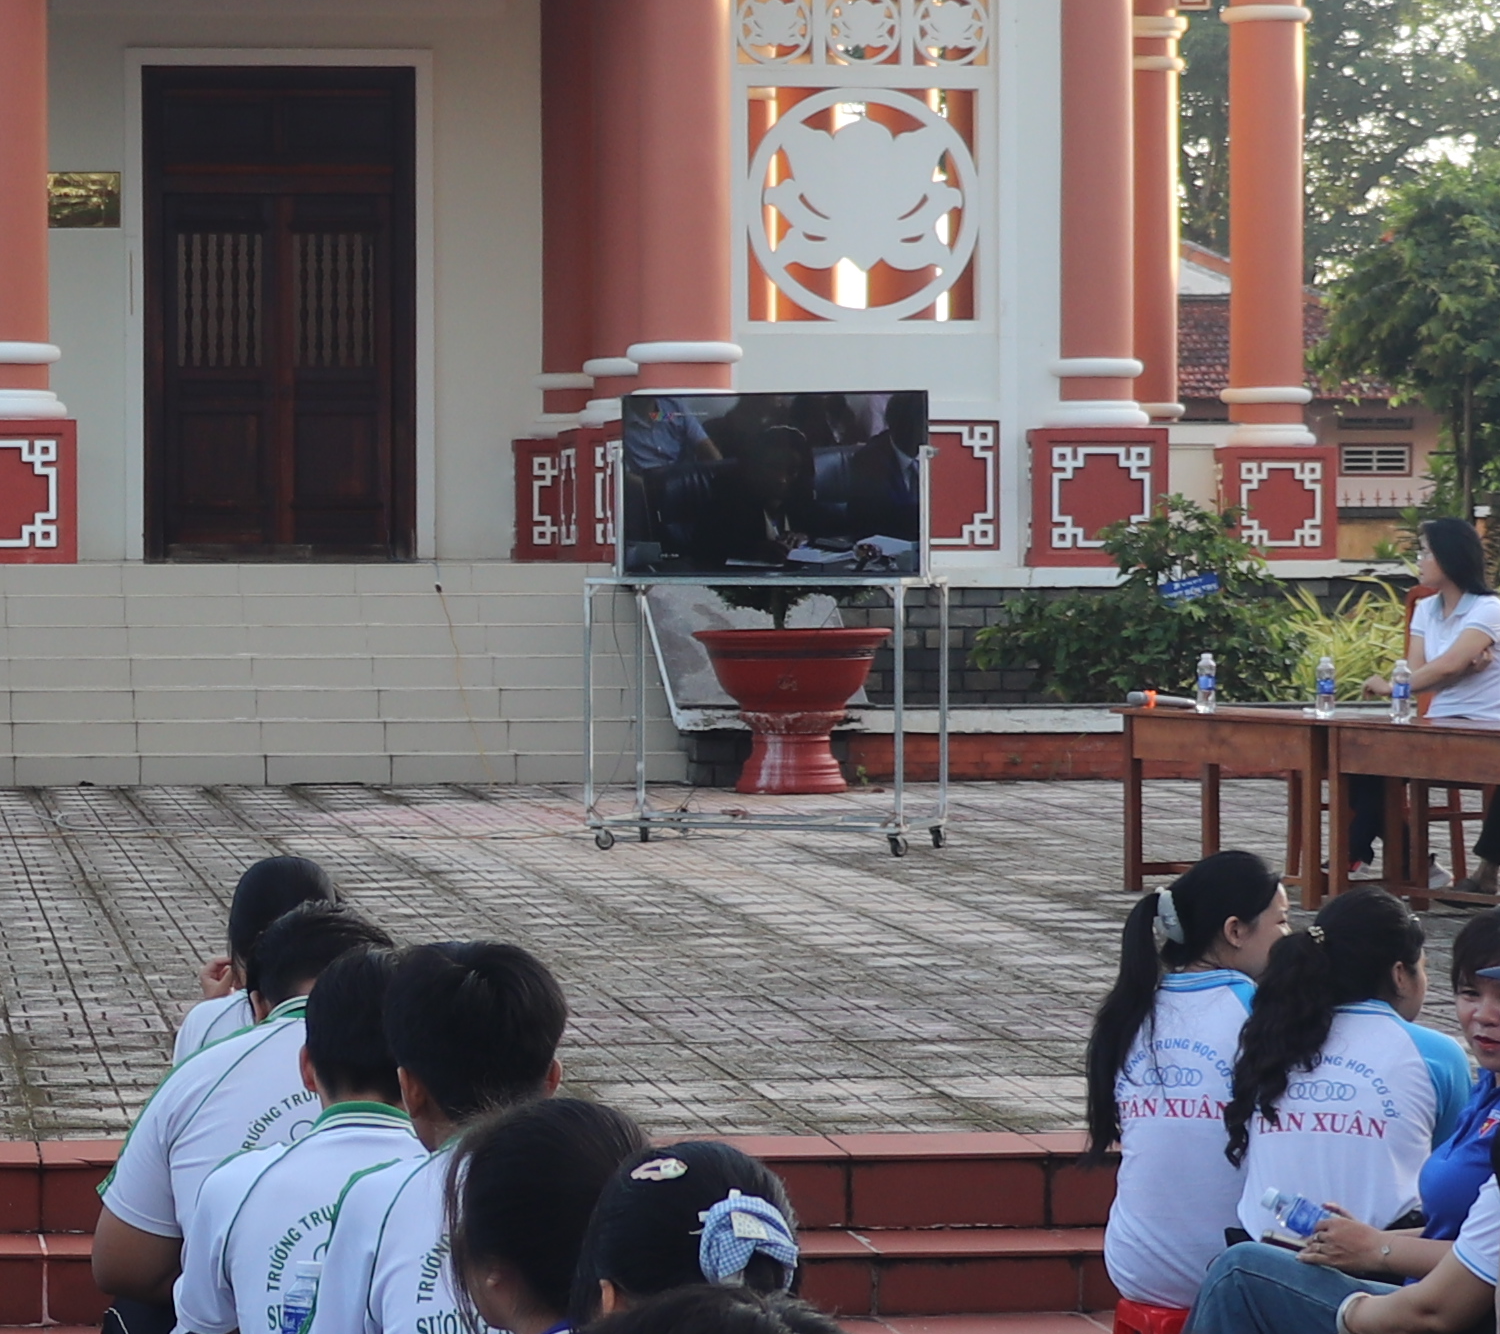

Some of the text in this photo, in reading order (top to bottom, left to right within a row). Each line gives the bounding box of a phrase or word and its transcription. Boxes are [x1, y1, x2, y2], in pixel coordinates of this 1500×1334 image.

[1154, 1037, 1190, 1051] RUNG
[1191, 1040, 1218, 1062] HỌC
[1345, 1057, 1374, 1080] HỌC
[1119, 1094, 1160, 1120] TÂN
[240, 1105, 283, 1151] RƯỜNG
[1256, 1108, 1388, 1140] TÂN XUÂN
[265, 1227, 304, 1294] TRƯỜNG
